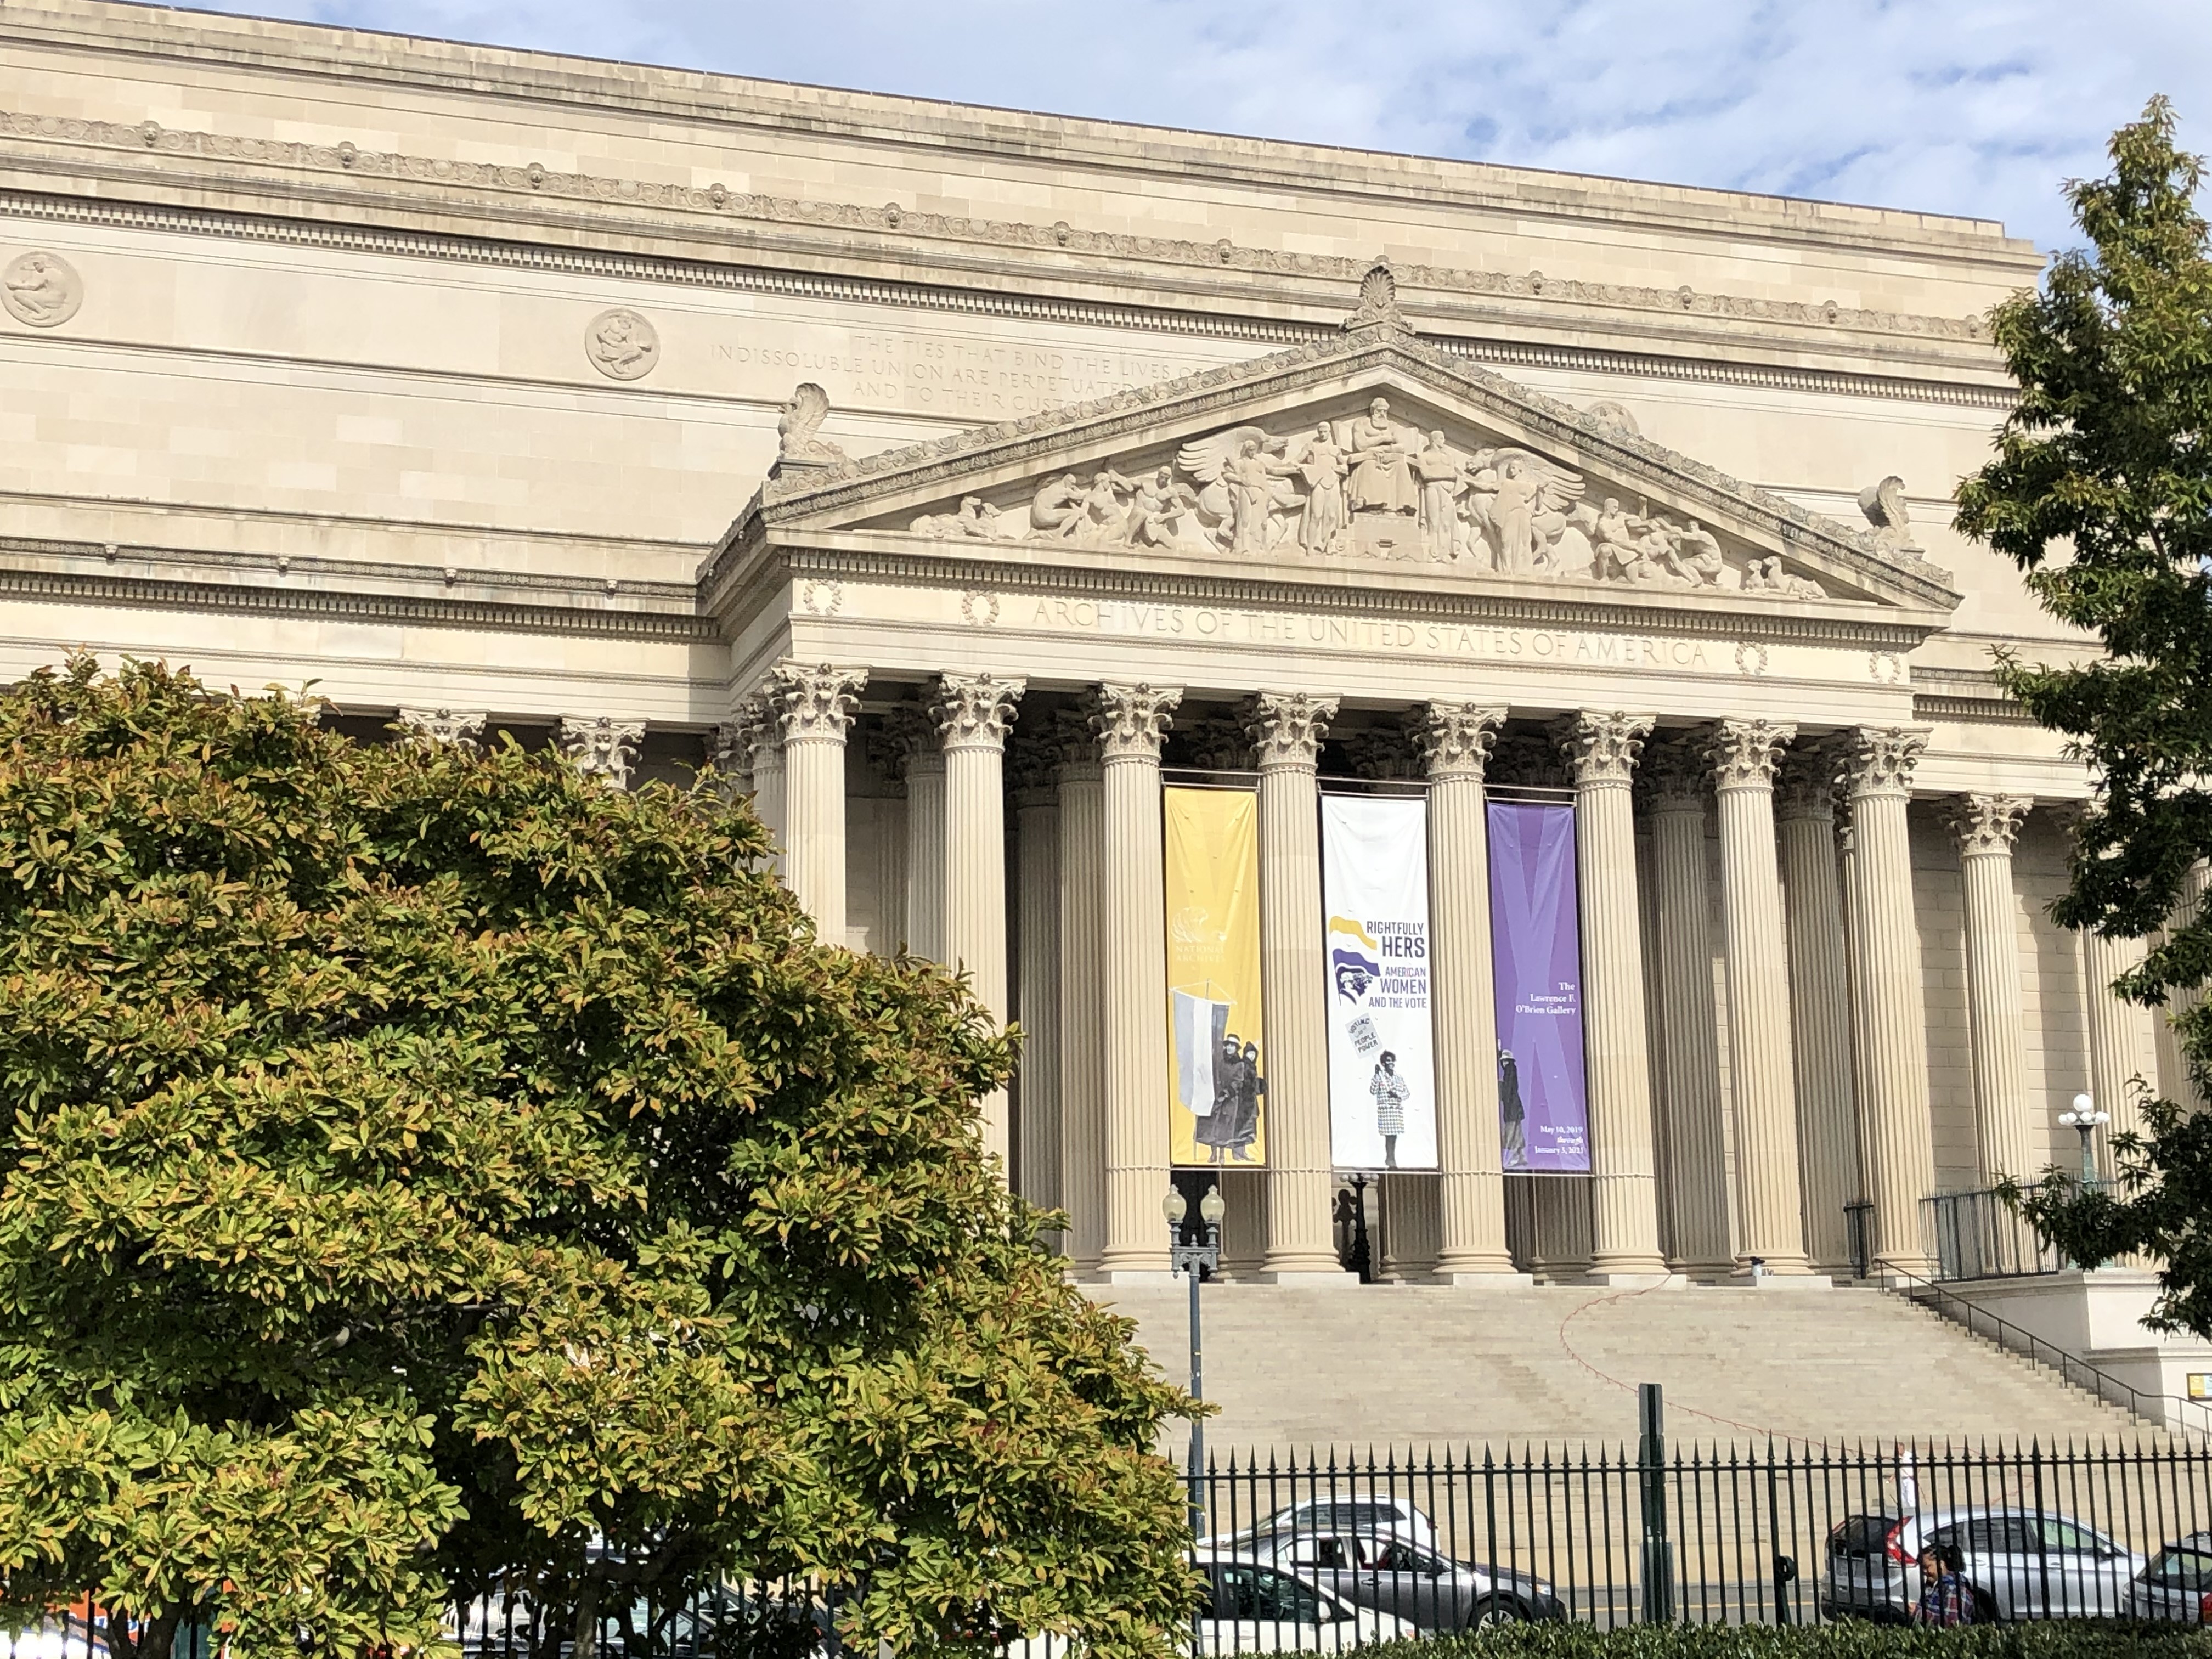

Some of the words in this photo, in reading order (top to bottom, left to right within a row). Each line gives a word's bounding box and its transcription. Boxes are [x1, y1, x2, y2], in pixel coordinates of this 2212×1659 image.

[710, 344, 864, 374] INDISSOLUBLE
[872, 359, 943, 380] UNION
[953, 368, 989, 386] ARE
[854, 336, 894, 354] THE
[903, 340, 945, 359] TIES
[953, 344, 1005, 363] THAT
[1015, 351, 1063, 370] BIND
[1073, 356, 1110, 375] THE
[1121, 361, 1170, 380] LIVES
[853, 381, 898, 399] AND
[905, 385, 933, 402] TO
[942, 388, 1005, 410] THEIR
[1032, 600, 1184, 633] ARCHIVES
[1195, 611, 1232, 637] OF
[1240, 613, 1295, 640] THE
[1306, 617, 1415, 647] UNITED
[1427, 625, 1522, 655] STATES
[1532, 632, 1567, 657] OF
[1575, 635, 1708, 666] AMERICA
[1367, 921, 1424, 935] RIGHTFULLY
[1176, 945, 1224, 953] NATIONAL
[1382, 935, 1425, 958] HERS
[1176, 954, 1226, 963] ARCHIVES
[1385, 966, 1426, 977] AMERICAN
[1379, 978, 1426, 995] WOMEN
[1558, 981, 1576, 991] The
[1368, 996, 1386, 1008] AND
[1388, 997, 1403, 1008] THE
[1404, 997, 1427, 1009] VOTE
[1530, 994, 1567, 1002] Lawrence
[1516, 1004, 1545, 1014] O'Brien
[1546, 1005, 1576, 1016] Gallery
[1348, 1018, 1370, 1034] VOTING
[1354, 1031, 1376, 1047] PEOPLE
[1358, 1039, 1379, 1053] POWER
[1540, 1125, 1555, 1135] May
[1555, 1126, 1566, 1134] 10,
[1566, 1126, 1583, 1134] 2019
